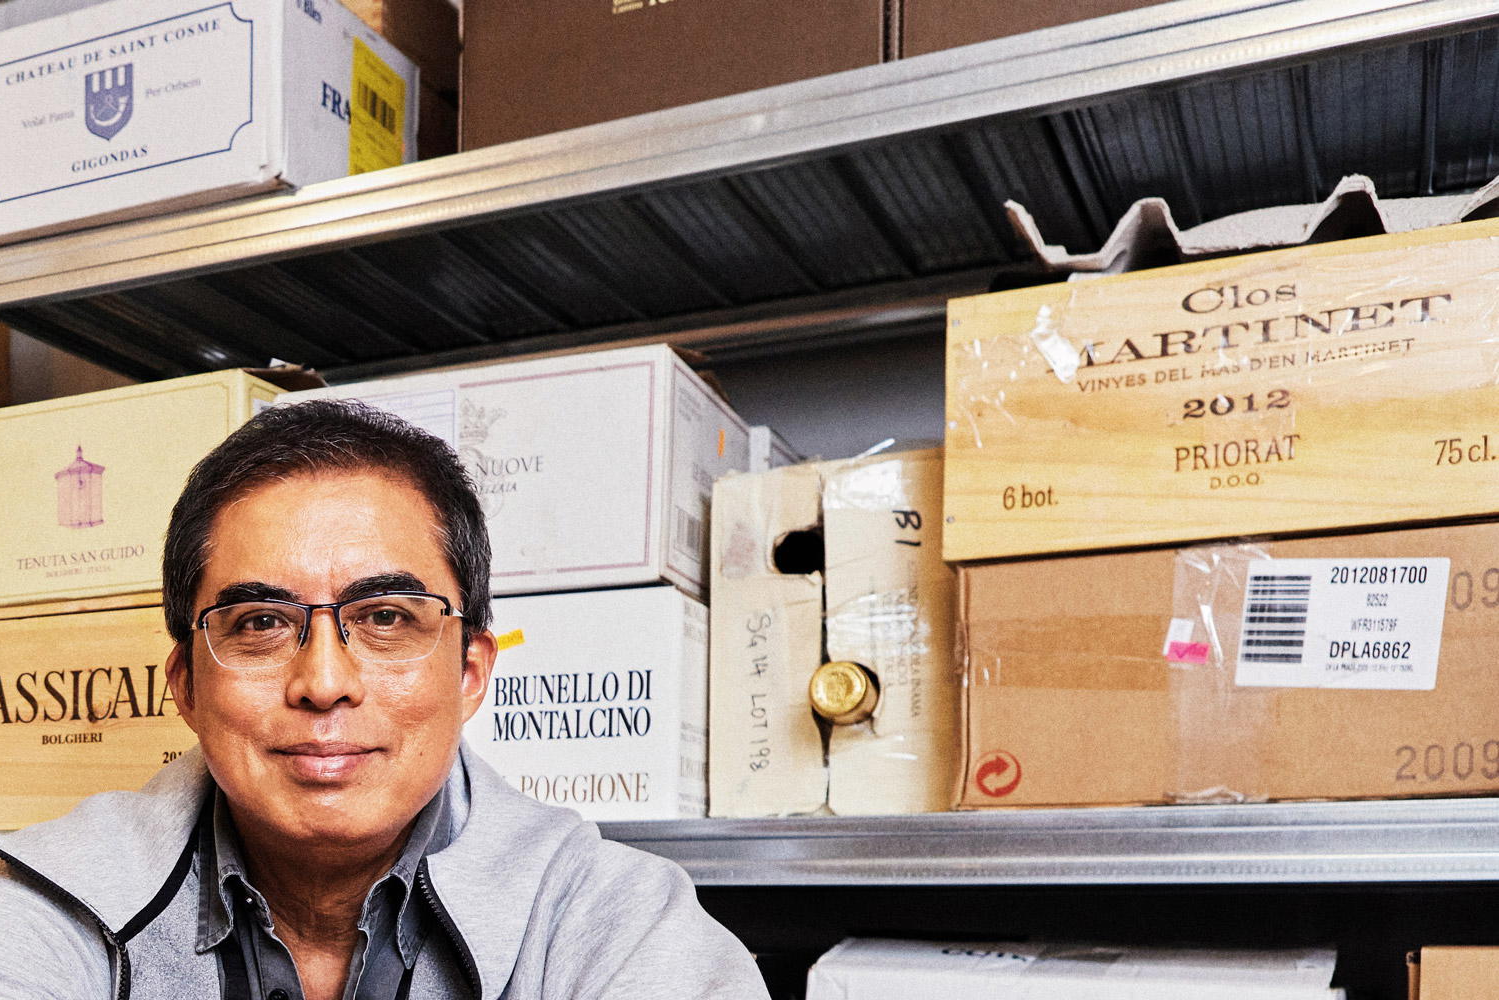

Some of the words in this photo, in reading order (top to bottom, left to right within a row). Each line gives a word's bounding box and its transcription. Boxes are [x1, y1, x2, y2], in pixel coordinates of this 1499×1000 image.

[5, 56, 78, 87] CHATEAU
[83, 51, 103, 66] DE
[109, 35, 157, 58] SAINT
[163, 18, 221, 45] COSME
[70, 144, 149, 174] GIGONDAS
[1180, 281, 1298, 315] Clos
[1076, 373, 1148, 394] VINYES
[1153, 364, 1193, 385] DEL
[1249, 351, 1297, 370] D'EN
[1304, 335, 1417, 364] MARTINET
[1181, 388, 1294, 420] 2012
[1173, 433, 1301, 473] PRIORAT
[1433, 437, 1463, 467] 75
[1467, 433, 1498, 464] cl.
[1002, 486, 1016, 512] 6
[1019, 483, 1059, 510] bot.
[16, 554, 69, 571] TENUTA
[69, 551, 97, 565] SAN
[100, 544, 146, 562] GUIDO
[1330, 565, 1429, 586] 2012081700
[1329, 640, 1413, 661] DPLA6862
[493, 671, 620, 707] BRUNELLO
[627, 669, 653, 701] DI
[41, 732, 104, 746] BOLGHERI
[492, 705, 653, 744] MONTALCINO
[1394, 739, 1499, 783] 2009
[520, 771, 651, 806] POGGIONE
